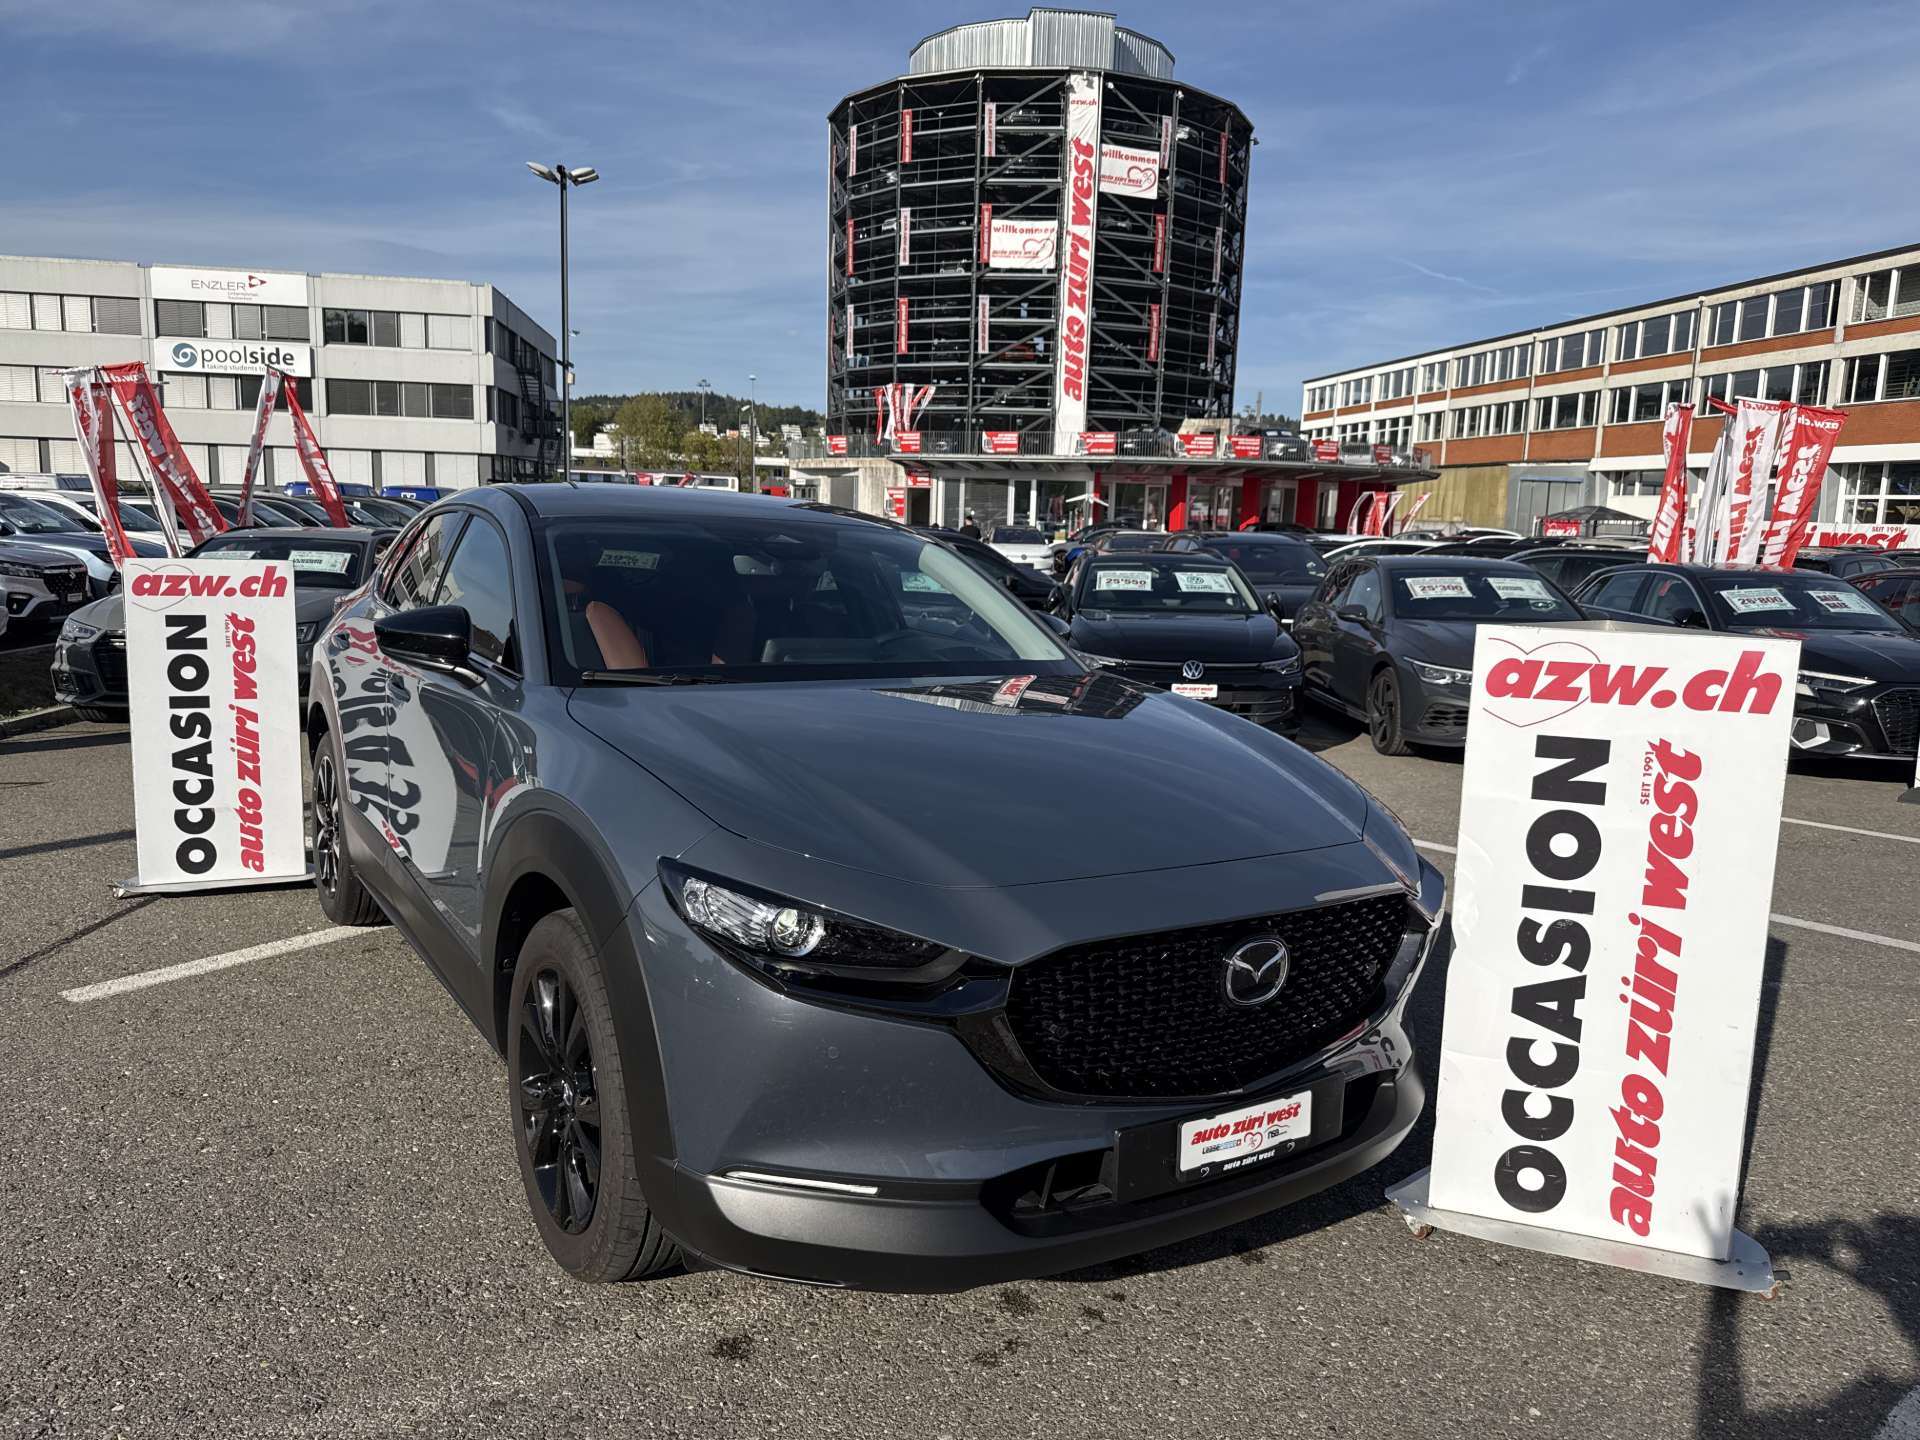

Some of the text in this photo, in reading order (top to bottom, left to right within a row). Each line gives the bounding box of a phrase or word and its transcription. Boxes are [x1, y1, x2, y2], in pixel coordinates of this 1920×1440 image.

[1101, 150, 1157, 165] willkommen
[191, 279, 246, 291] ENZLER
[1063, 137, 1094, 401] auto züri west
[201, 345, 295, 368] poolside
[132, 565, 288, 597] azw.ch
[1485, 651, 1783, 715] azw.ch
[165, 614, 217, 875] OCCASION
[224, 612, 265, 874] auto züri west
[1640, 751, 1655, 806] SEIT 1991
[1494, 734, 1611, 1213] OCCASION
[1609, 738, 1702, 1237] auto züri west
[1191, 1124, 1231, 1146] auto
[1231, 1111, 1266, 1137] züri
[1266, 1102, 1302, 1126] west
